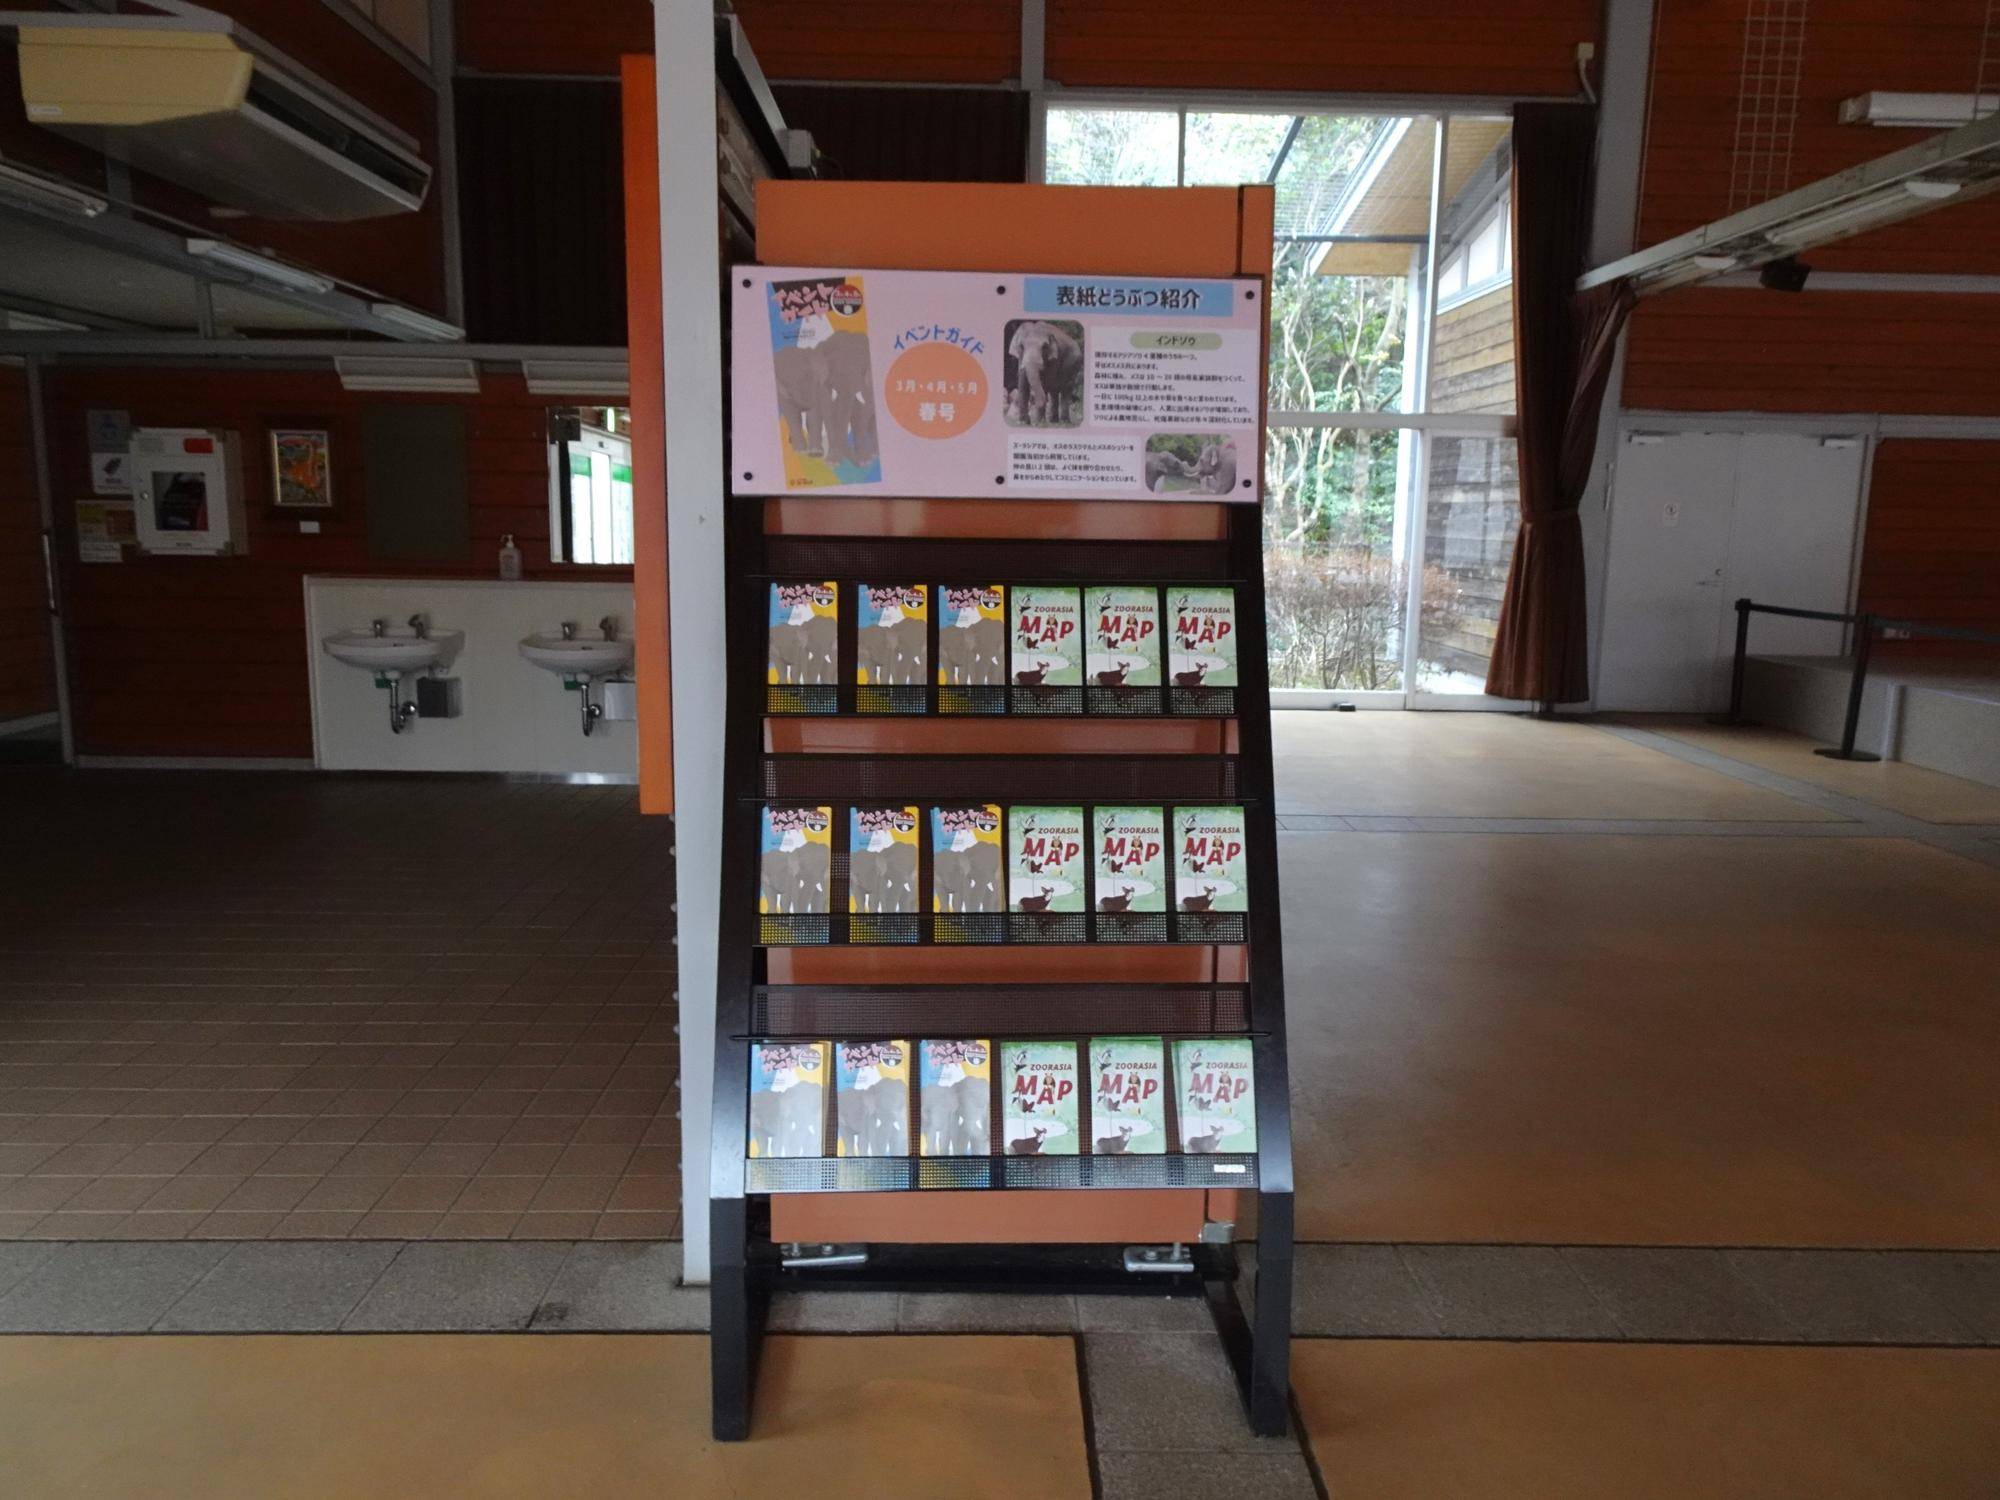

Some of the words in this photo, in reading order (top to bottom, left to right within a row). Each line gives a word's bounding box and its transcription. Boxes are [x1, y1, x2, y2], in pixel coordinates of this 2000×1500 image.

[1056, 285, 1200, 309] 表紙どうぶつ紹介
[894, 324, 985, 354] イベントガイド
[1156, 335, 1196, 346] インドゾウ
[896, 380, 977, 395] 3月・4月・5月
[919, 402, 956, 422] 春号
[1114, 605, 1154, 613] ZOORASIA
[1191, 606, 1231, 614] ZOORASIA
[1019, 615, 1074, 642] MAP
[1099, 615, 1155, 642] MAP
[1176, 616, 1232, 643] MAP
[1038, 827, 1080, 835] ZOORASIA
[1118, 827, 1160, 835] ZOORASIA
[1199, 826, 1241, 834] ZOORASIA
[1022, 837, 1081, 866] MAP
[1103, 837, 1161, 866] MAP
[1184, 837, 1242, 866] MAP
[1029, 1063, 1073, 1071] ZOORASIA
[1115, 1062, 1158, 1070] ZOORASIA
[1205, 1061, 1248, 1070] ZOORASIA
[1013, 1074, 1074, 1105] MAP
[1098, 1073, 1159, 1104] MAP
[1189, 1073, 1249, 1103] MAP
